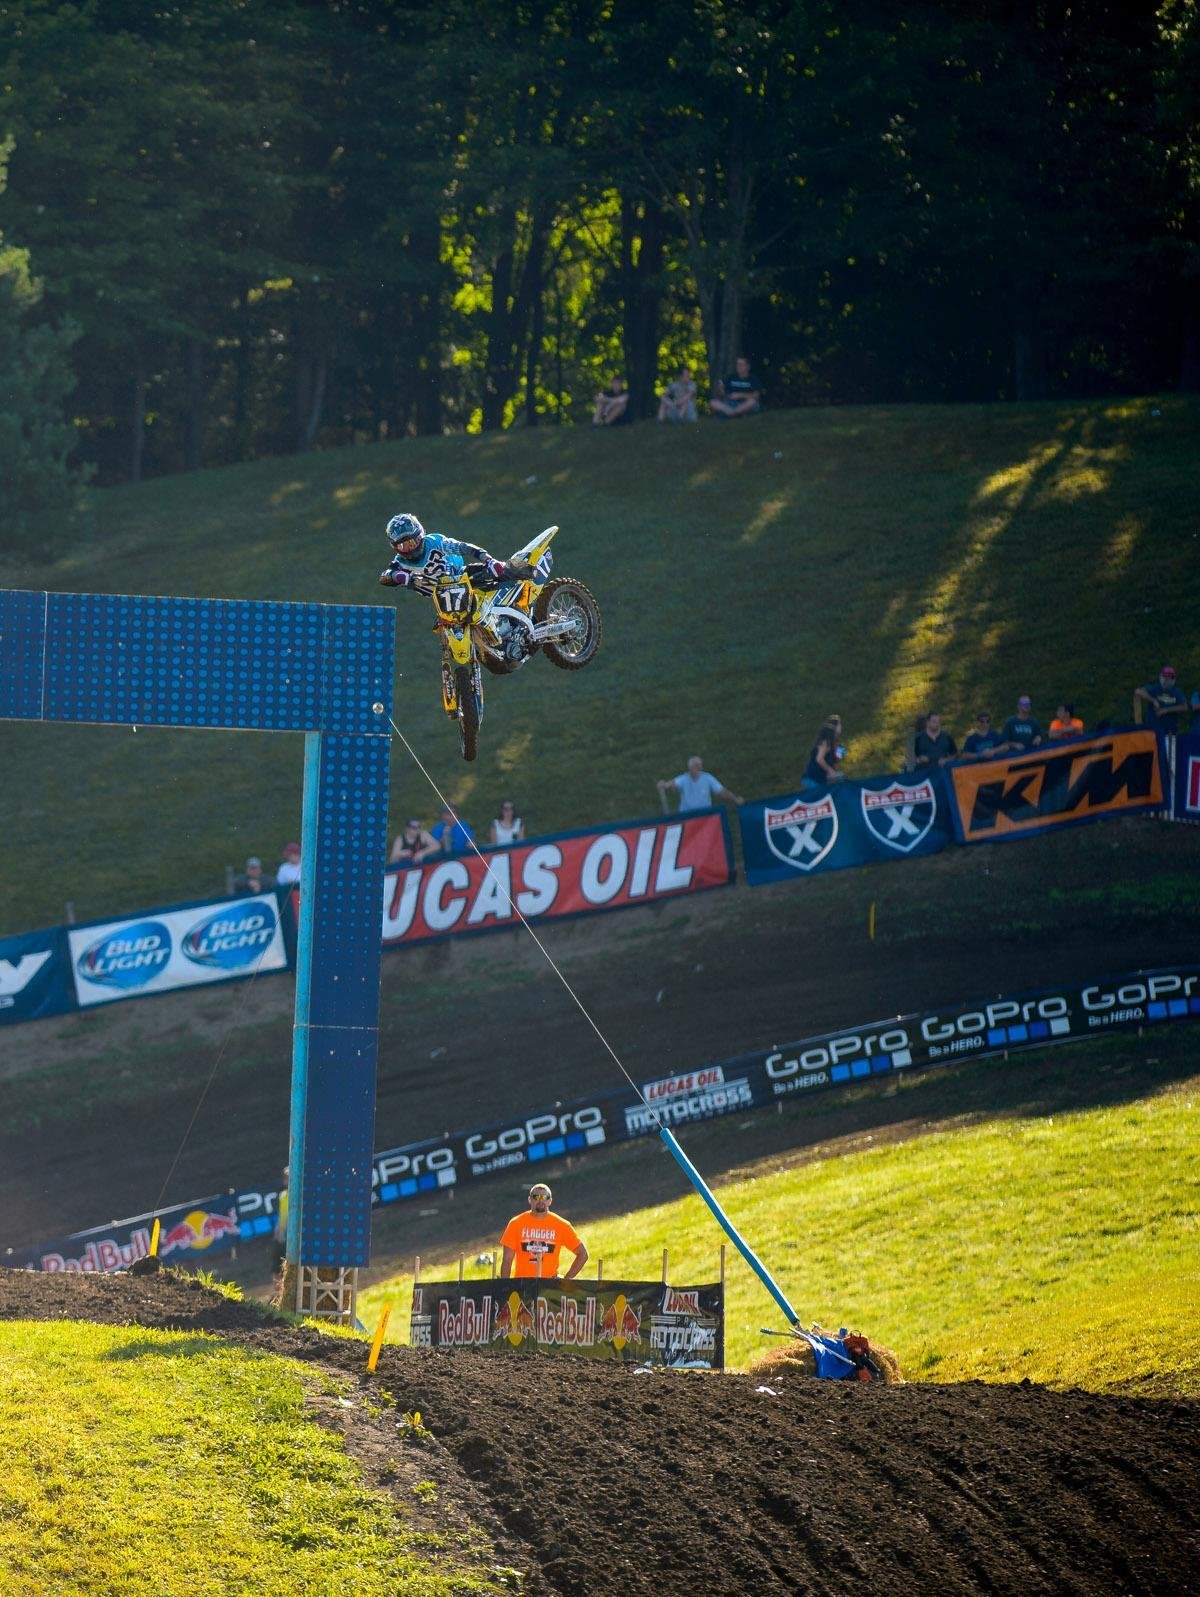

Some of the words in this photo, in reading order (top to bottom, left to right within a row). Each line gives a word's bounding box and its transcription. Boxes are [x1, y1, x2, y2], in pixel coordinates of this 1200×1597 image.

[440, 588, 466, 612] 17
[866, 786, 931, 806] RACER
[969, 743, 1153, 832] KTM
[770, 803, 831, 825] RACER
[884, 805, 921, 839] X
[785, 820, 823, 857] X
[382, 844, 563, 940] UCAS
[581, 824, 694, 904] OIL
[198, 927, 274, 954] LIGHT
[209, 915, 265, 938] BUD
[94, 948, 171, 975] LIGHT
[105, 935, 161, 958] BUD
[1082, 975, 1200, 1010] GoPr
[921, 997, 1067, 1041] GoPro
[765, 1029, 908, 1078] GoPro
[649, 1074, 694, 1099] LUCAS
[697, 1070, 719, 1086] OIL
[625, 1083, 753, 1130] MOTOCROSS
[465, 1106, 602, 1160] GoPro
[372, 1148, 454, 1187] Pro
[97, 1228, 151, 1272] Bull
[522, 1227, 556, 1240] FLAGGER
[439, 1297, 466, 1345] Red
[465, 1296, 492, 1344] Bull
[537, 1296, 566, 1345] Red
[566, 1297, 596, 1346] Bull
[650, 1326, 717, 1351] MOTOCROSS
